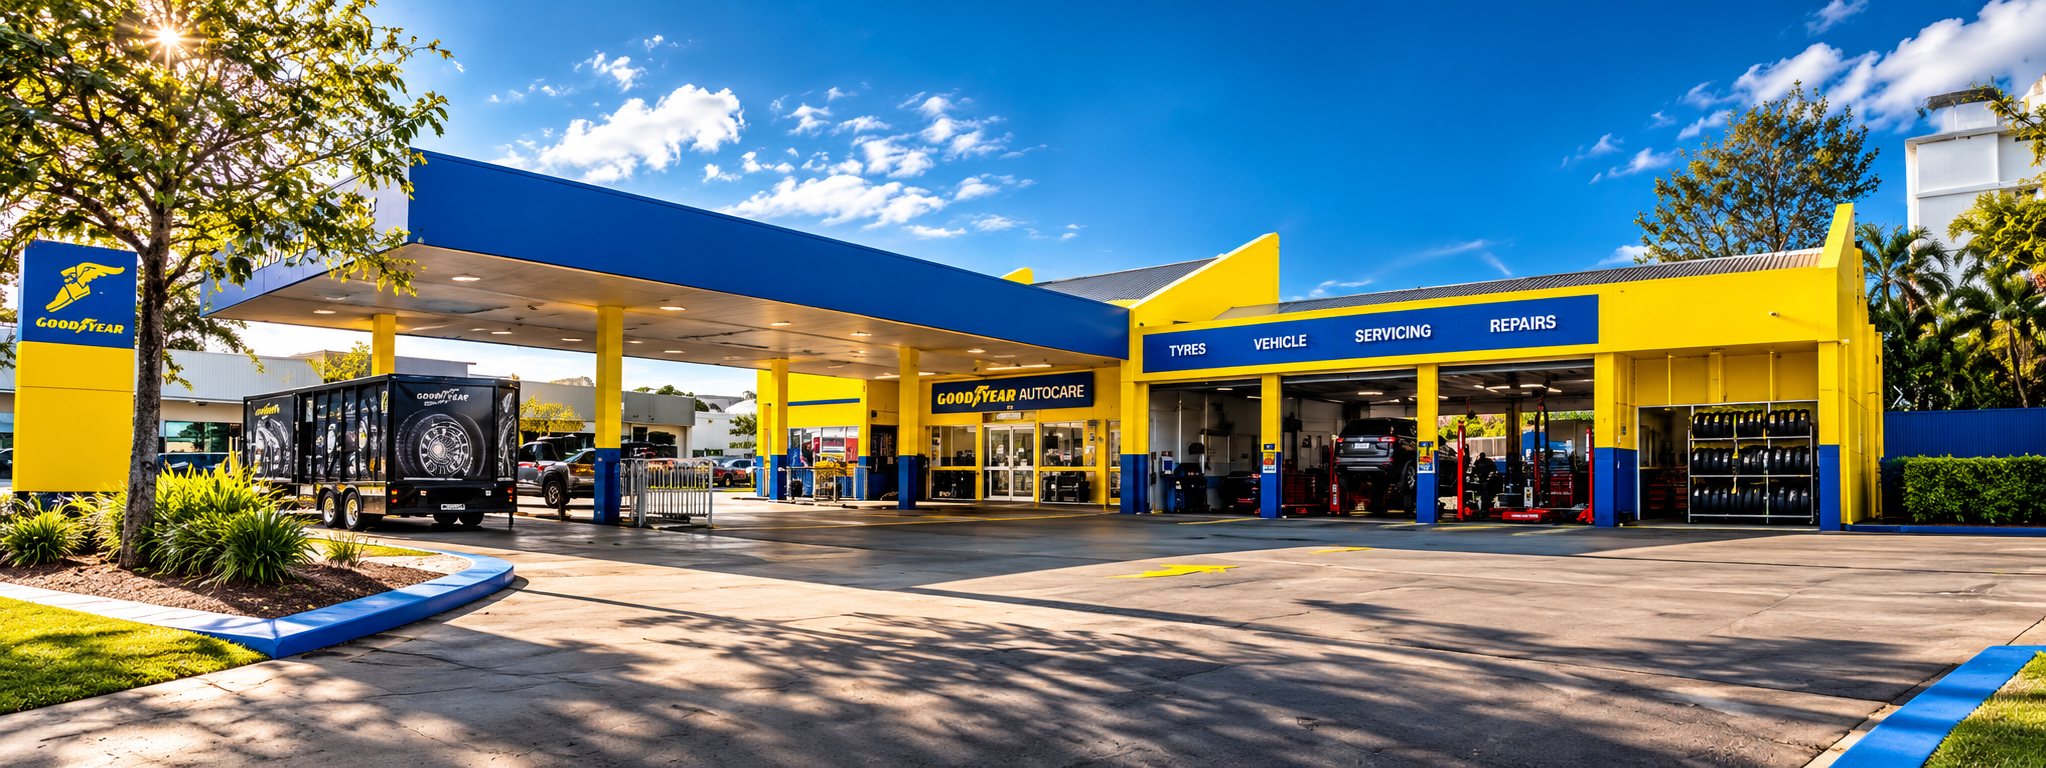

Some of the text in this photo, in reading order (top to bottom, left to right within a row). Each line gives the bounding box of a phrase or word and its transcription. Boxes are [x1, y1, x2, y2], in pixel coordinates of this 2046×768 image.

[36, 317, 124, 334] GOODYEAR
[1169, 315, 1557, 357] TYRES VEHICLE SERVICING REPAIRS
[937, 385, 1084, 407] GOODYEAR AUTOCARE
